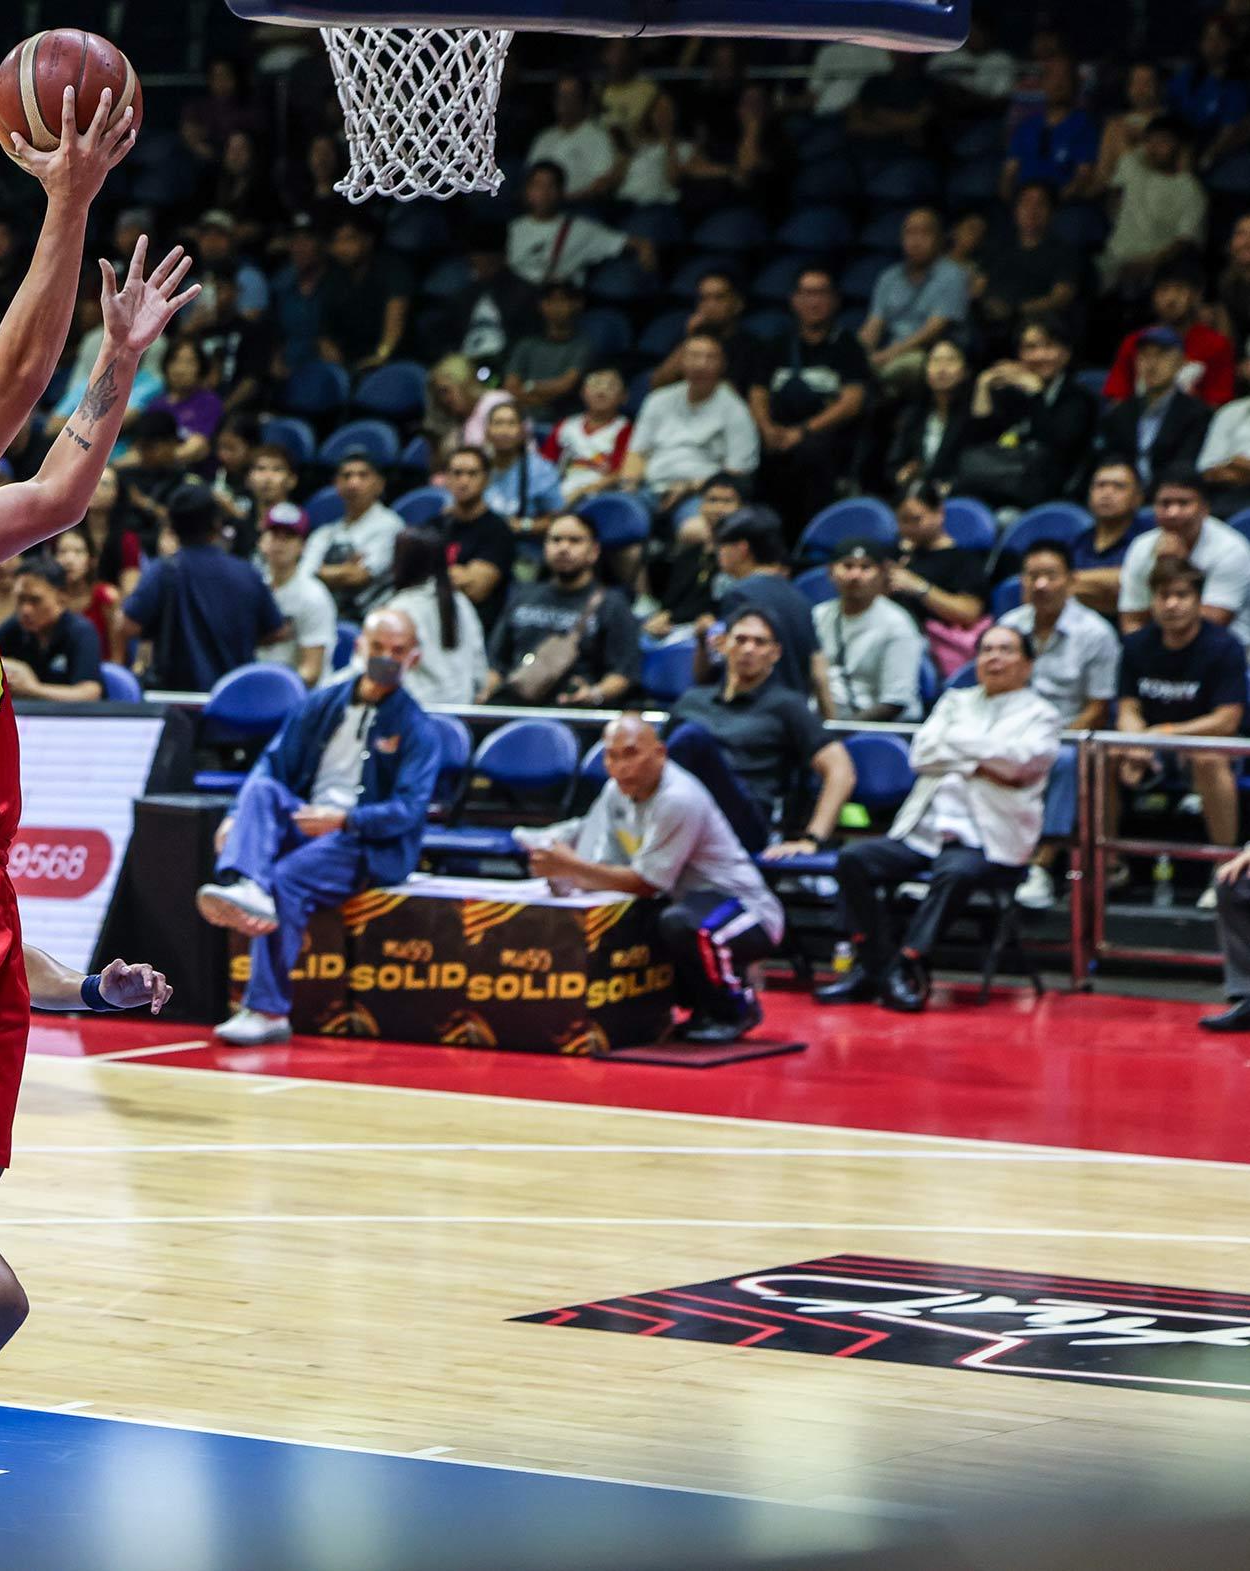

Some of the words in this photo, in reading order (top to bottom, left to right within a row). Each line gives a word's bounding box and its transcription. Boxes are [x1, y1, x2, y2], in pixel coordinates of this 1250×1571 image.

[229, 954, 346, 982] SID
[350, 962, 468, 992] SOLID
[466, 971, 587, 1001] SOLID
[586, 963, 674, 1009] SOLID
